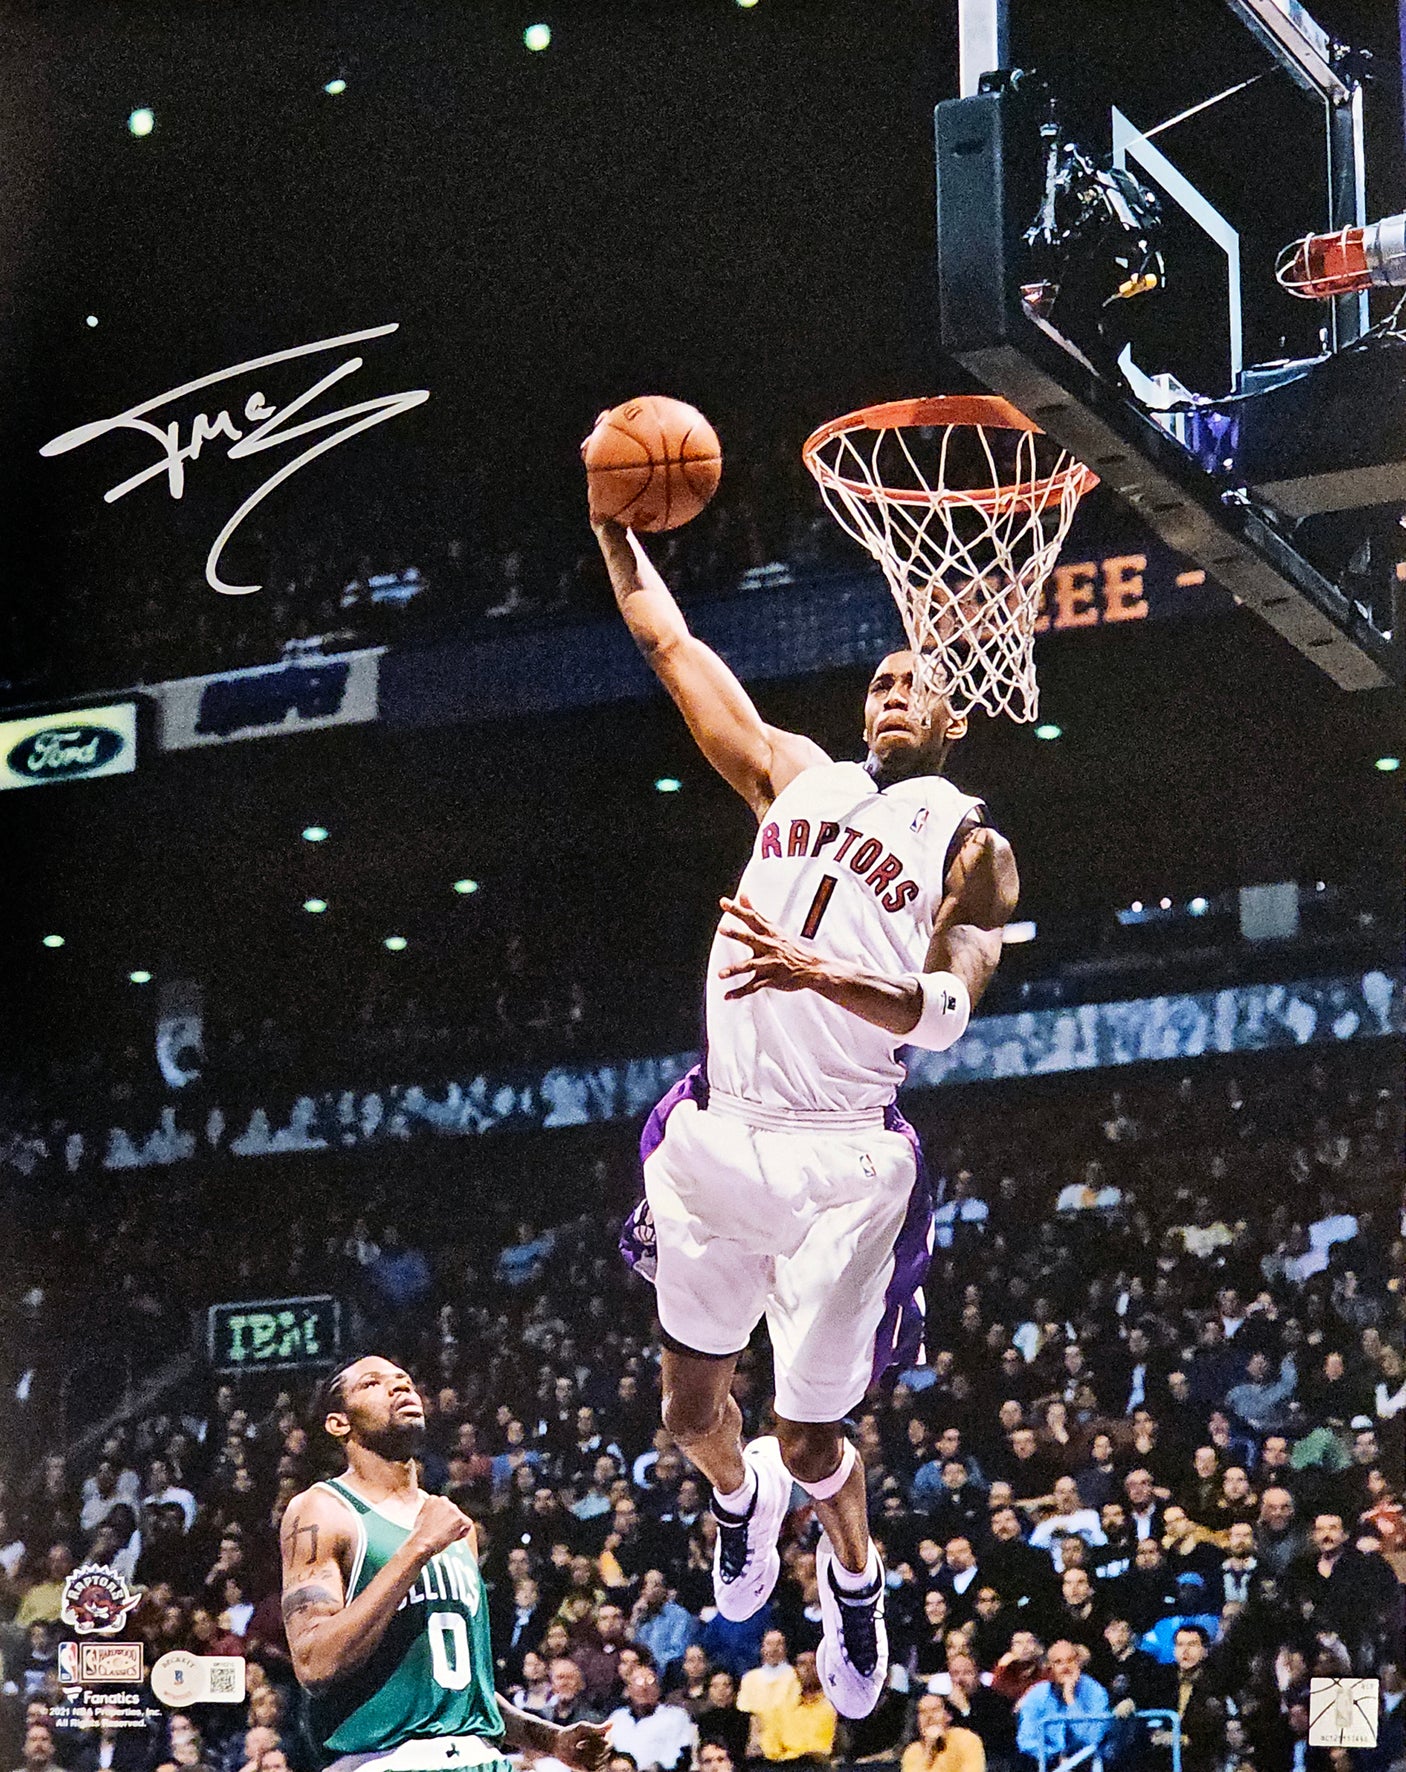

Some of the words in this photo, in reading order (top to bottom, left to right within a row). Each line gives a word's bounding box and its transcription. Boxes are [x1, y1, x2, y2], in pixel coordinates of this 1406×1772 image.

[27, 731, 99, 771] Ford
[761, 819, 919, 913] RAPTORS
[800, 874, 838, 940] 1
[428, 1612, 472, 1691] 0
